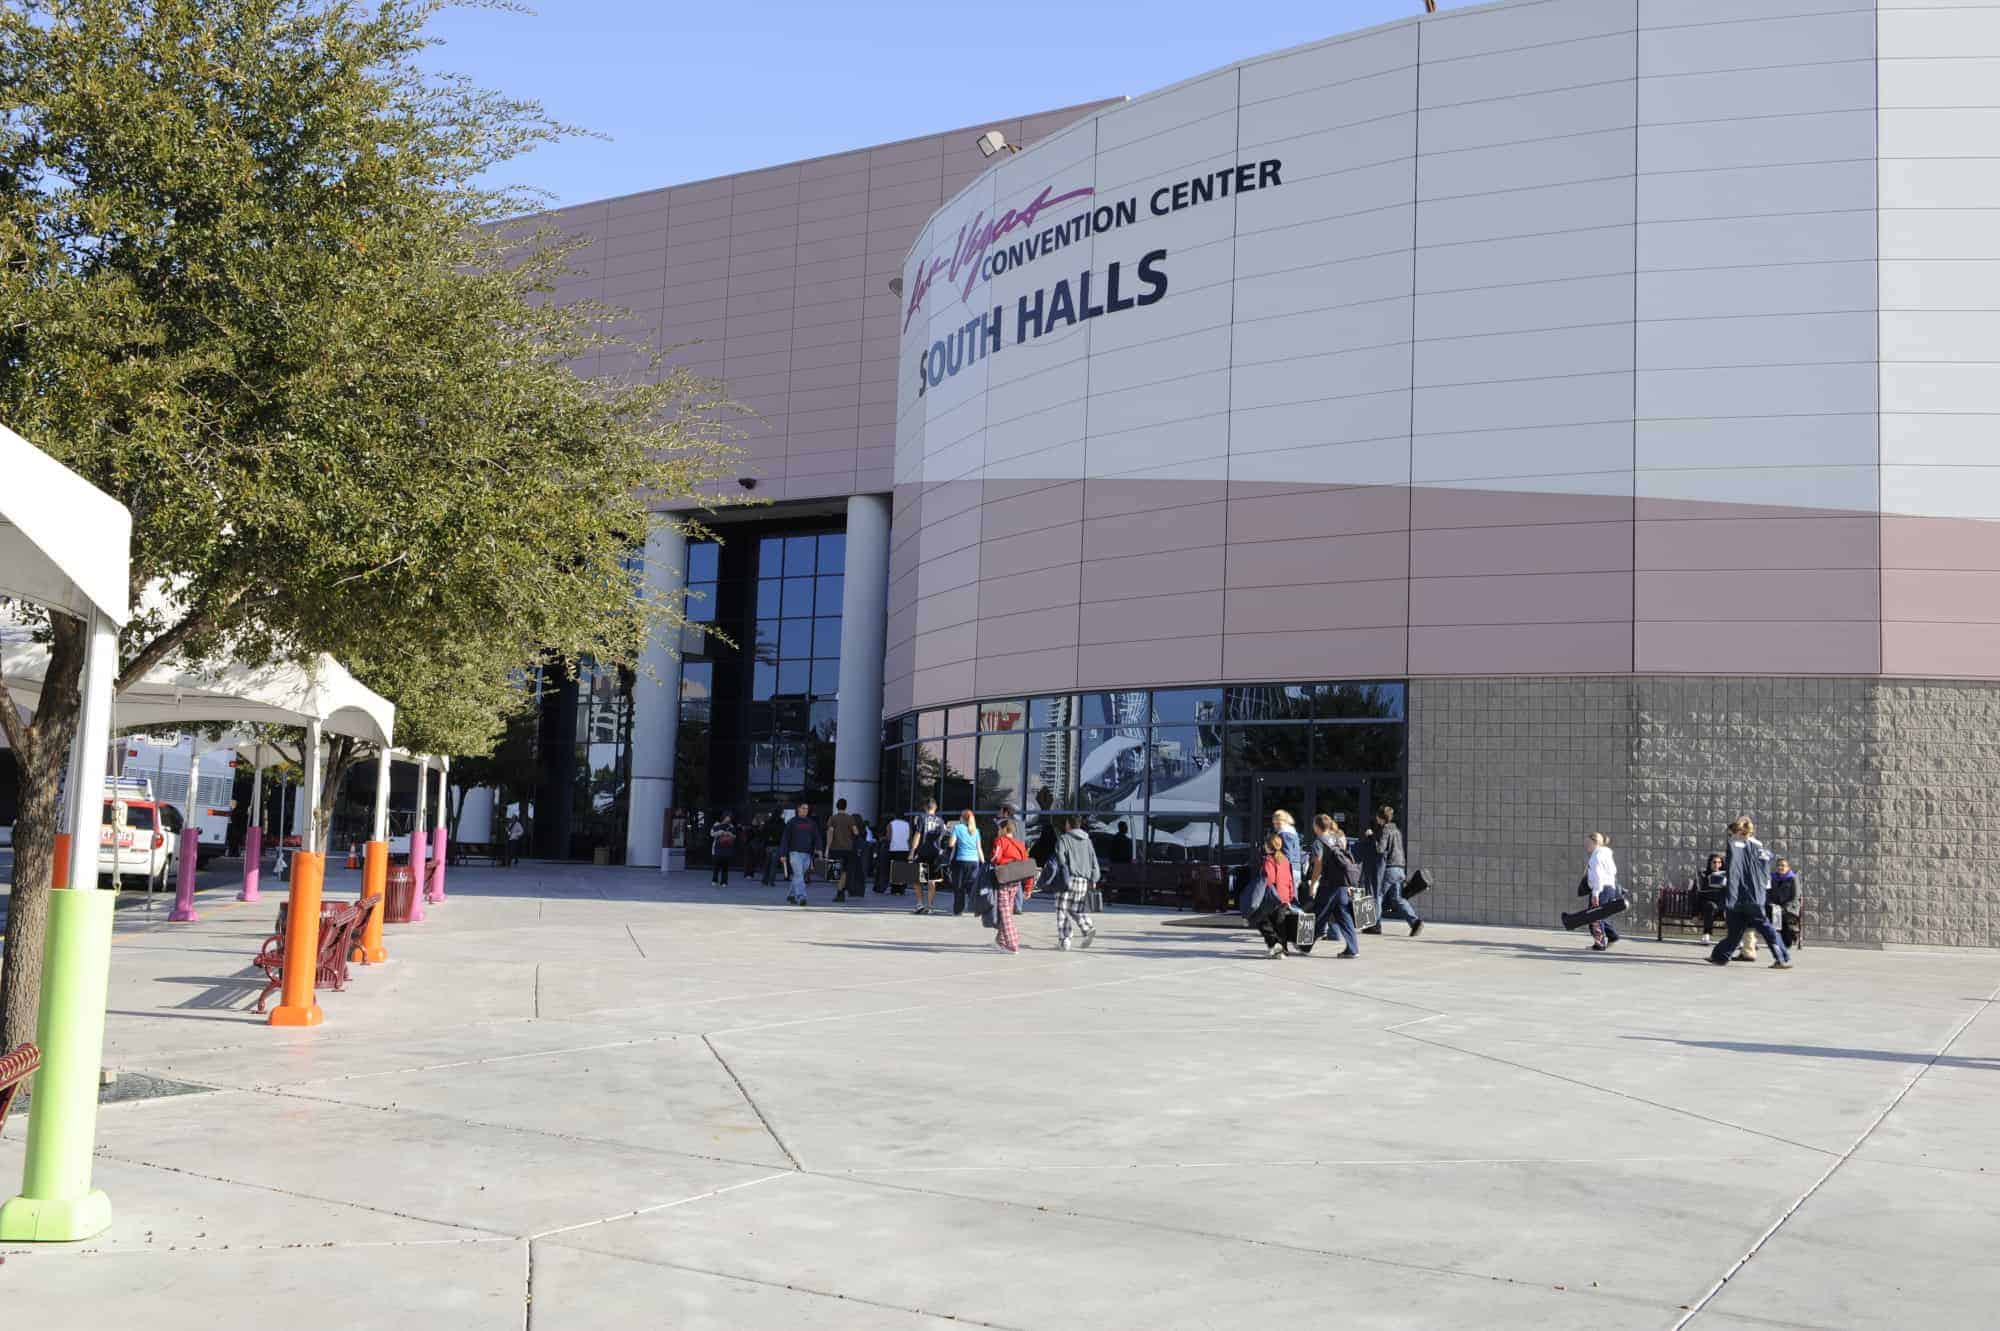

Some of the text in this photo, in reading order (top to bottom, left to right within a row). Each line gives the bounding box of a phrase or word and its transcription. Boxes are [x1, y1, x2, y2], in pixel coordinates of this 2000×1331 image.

[949, 186, 1095, 302] Vegas
[982, 159, 1282, 281] CONVENTION CENTER
[919, 249, 1168, 397] SOUTH HALLS
